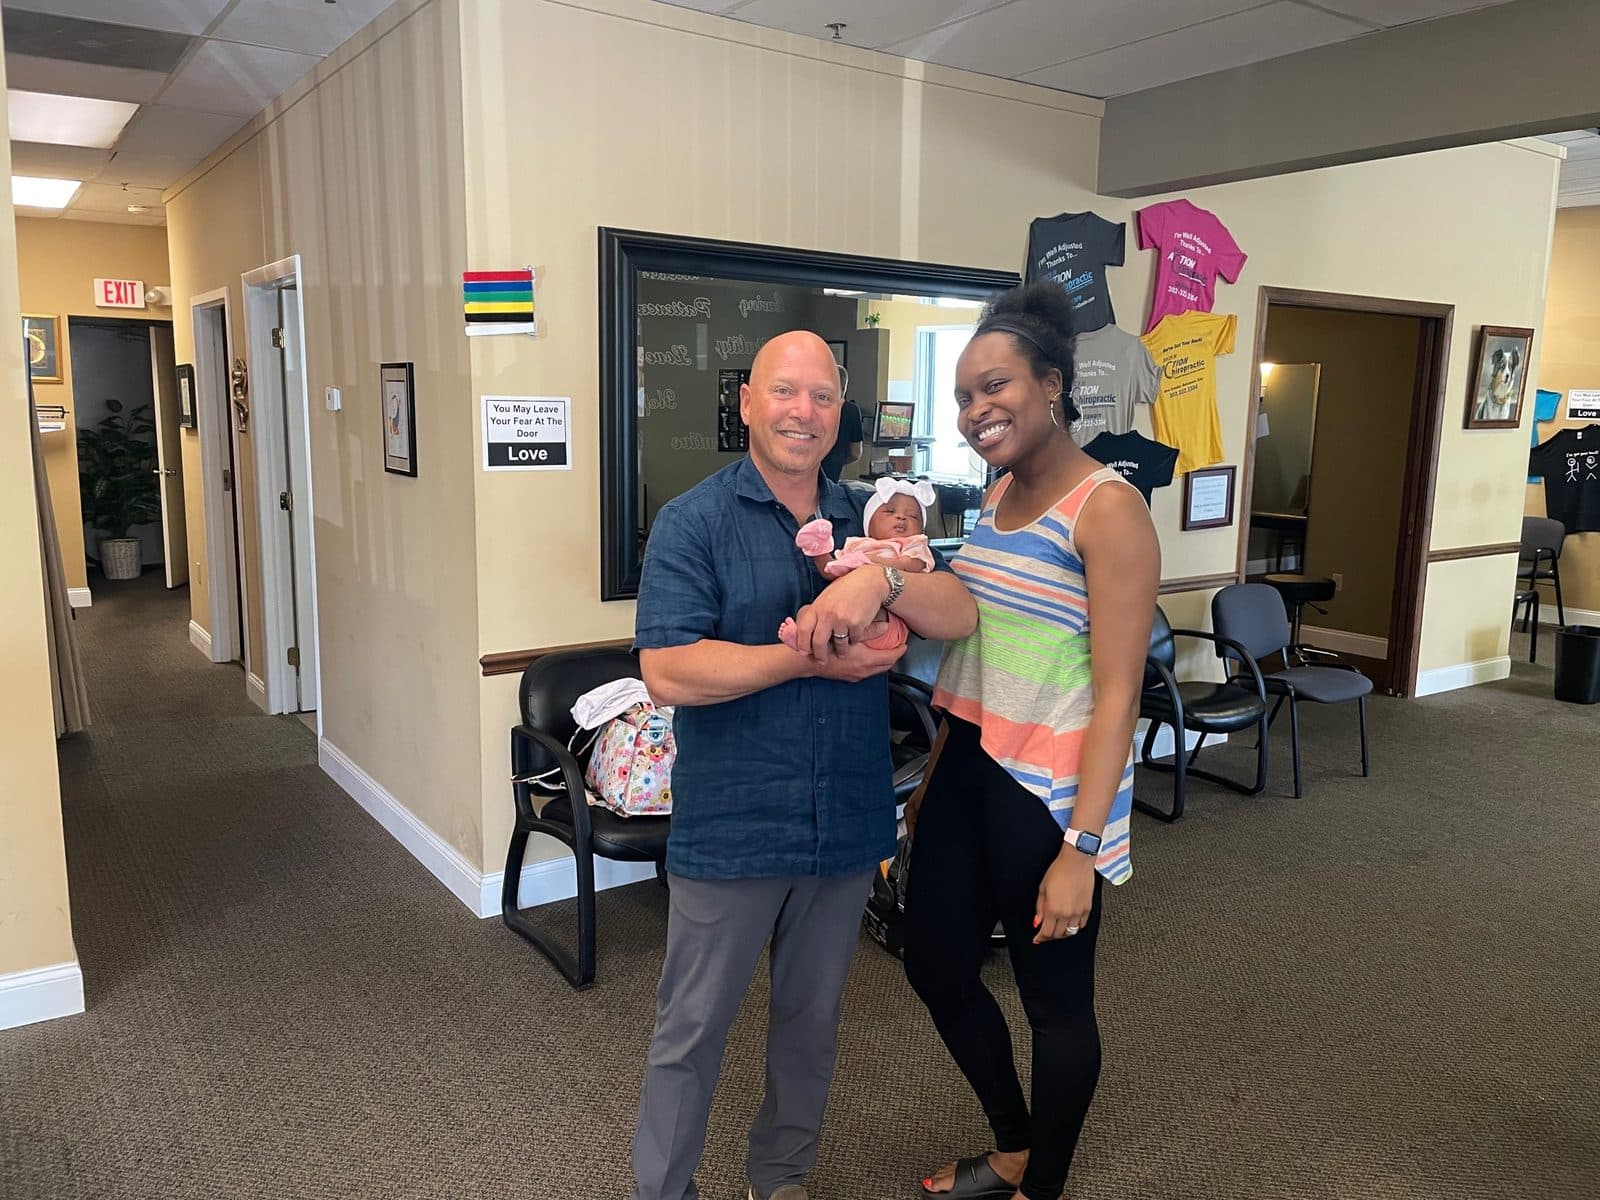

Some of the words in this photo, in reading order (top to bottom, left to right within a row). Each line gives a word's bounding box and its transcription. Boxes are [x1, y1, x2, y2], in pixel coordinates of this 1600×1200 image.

[1057, 242, 1083, 252] Adjusted
[1046, 256, 1066, 269] Thanks
[103, 280, 137, 305] EXIT
[1090, 359, 1116, 371] Adjusted
[493, 404, 511, 413] You
[513, 404, 531, 415] May
[533, 404, 559, 414] Leave
[1577, 409, 1597, 417] Love
[490, 416, 511, 425] Your
[513, 417, 533, 426] Fear
[534, 417, 545, 426] At
[546, 417, 563, 426] The
[516, 429, 538, 438] Door
[507, 446, 549, 461] Love
[1117, 459, 1140, 470] Adjusted
